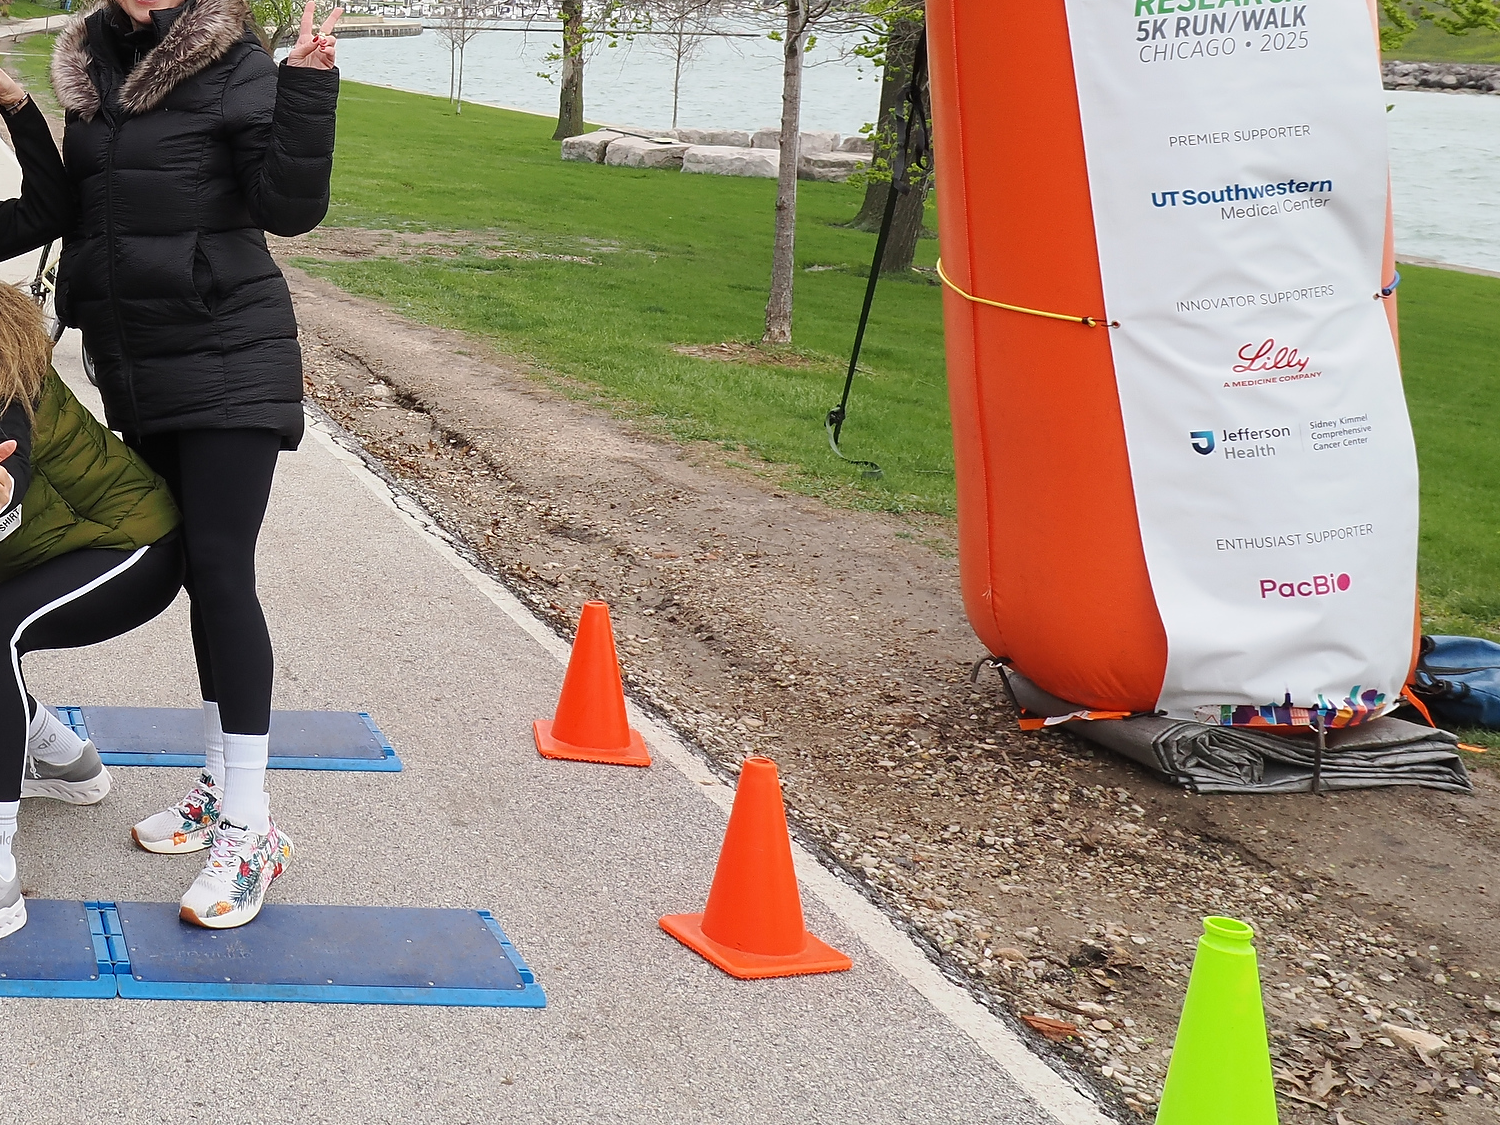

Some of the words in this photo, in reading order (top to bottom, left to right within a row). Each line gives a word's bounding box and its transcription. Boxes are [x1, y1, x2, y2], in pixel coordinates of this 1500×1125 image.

[1136, 18, 1168, 43] 5K
[1175, 5, 1307, 38] RUN/WALK
[1139, 37, 1236, 63] CHICAGO
[1260, 30, 1309, 53] 2025
[1169, 132, 1230, 147] PREMIER
[1233, 124, 1311, 142] SUPPORTER
[1221, 202, 1280, 220] Medical
[1283, 196, 1330, 213] Center
[1175, 293, 1257, 313] INNOVATOR
[1260, 284, 1335, 306] SUPPORTERS
[1232, 337, 1311, 373] Lilly
[1232, 375, 1277, 388] MEDICINE
[1278, 371, 1323, 385] COMPANY
[1309, 418, 1338, 431] Sidney
[1339, 413, 1368, 425] Kimmel
[1310, 423, 1373, 441] Comprehensive
[1221, 424, 1291, 444] Jefferson
[1313, 439, 1342, 452] Cancer
[1343, 435, 1369, 448] Center
[1224, 443, 1277, 460] Health
[1216, 533, 1302, 552] ENTHUSIAST
[1305, 523, 1374, 545] SUPPORTER
[1260, 572, 1351, 600] PacBio
[38, 734, 56, 749] alo
